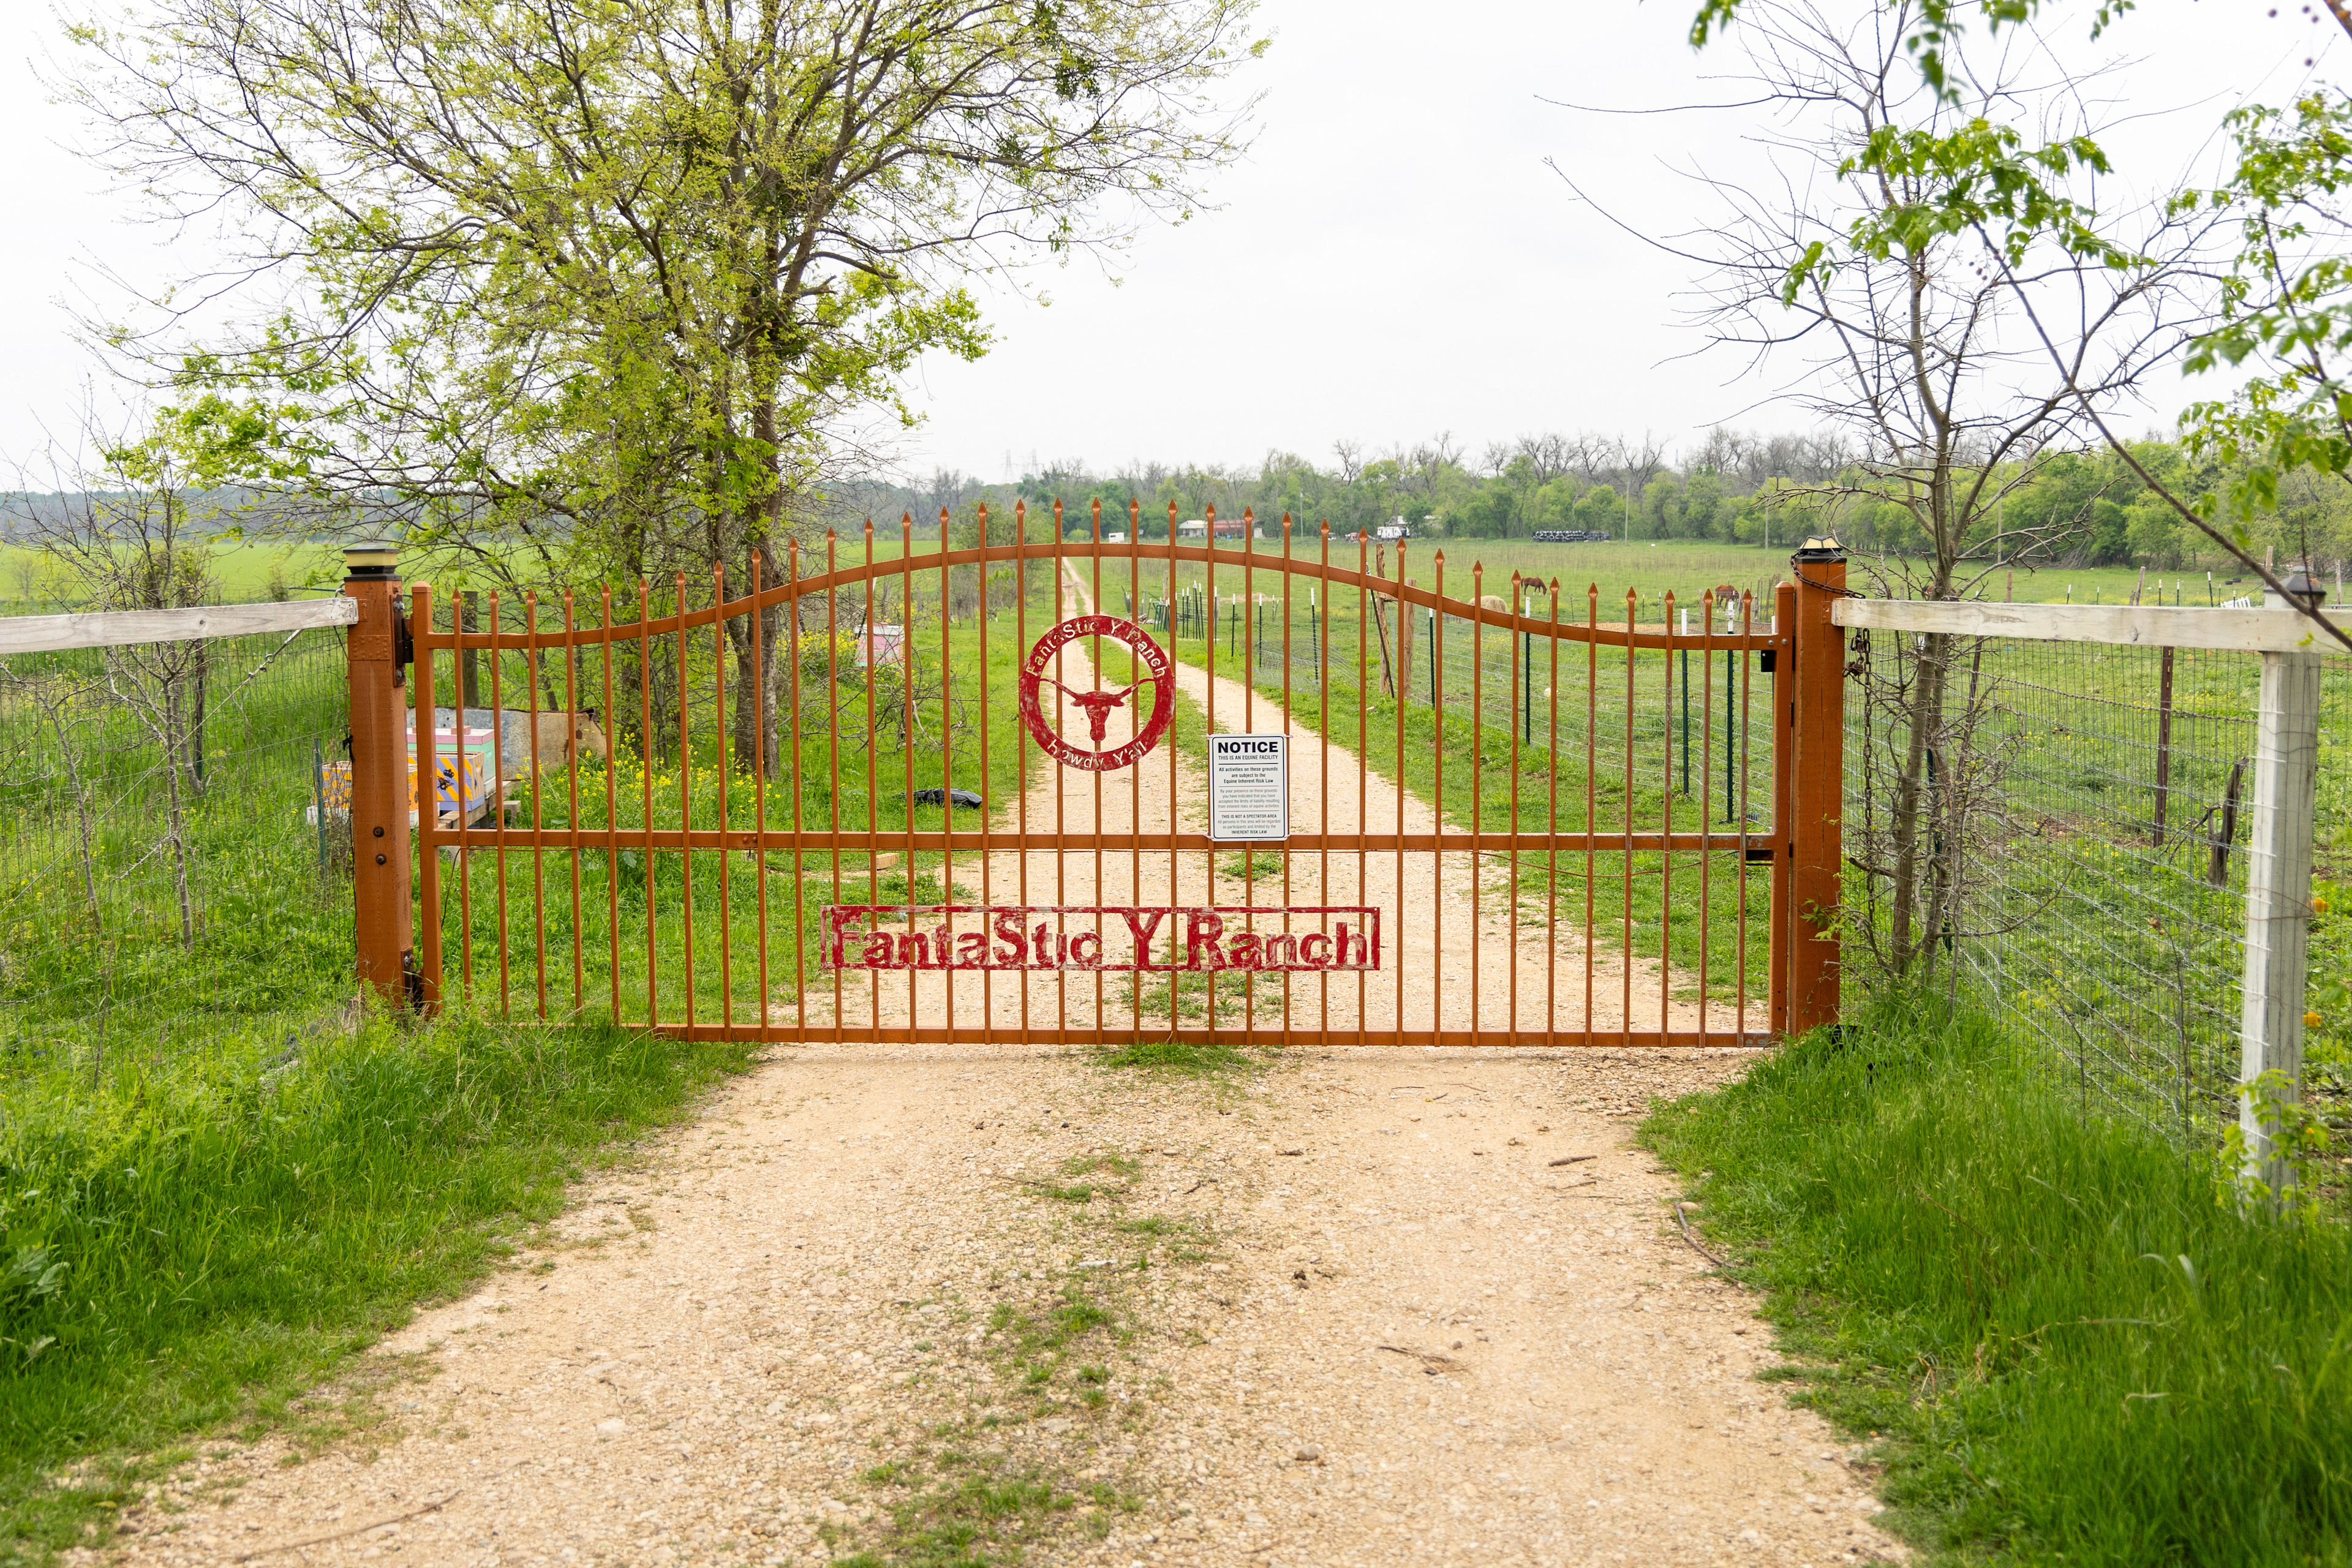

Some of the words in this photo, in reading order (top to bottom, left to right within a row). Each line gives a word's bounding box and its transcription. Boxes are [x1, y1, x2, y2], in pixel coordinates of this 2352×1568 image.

[1026, 620, 1098, 676] FantaStic
[1110, 619, 1122, 635] Y
[1126, 629, 1167, 677] Ranch
[1218, 742, 1278, 753] NOTICE
[1122, 907, 1164, 970] Y
[1187, 907, 1368, 970] Ranch
